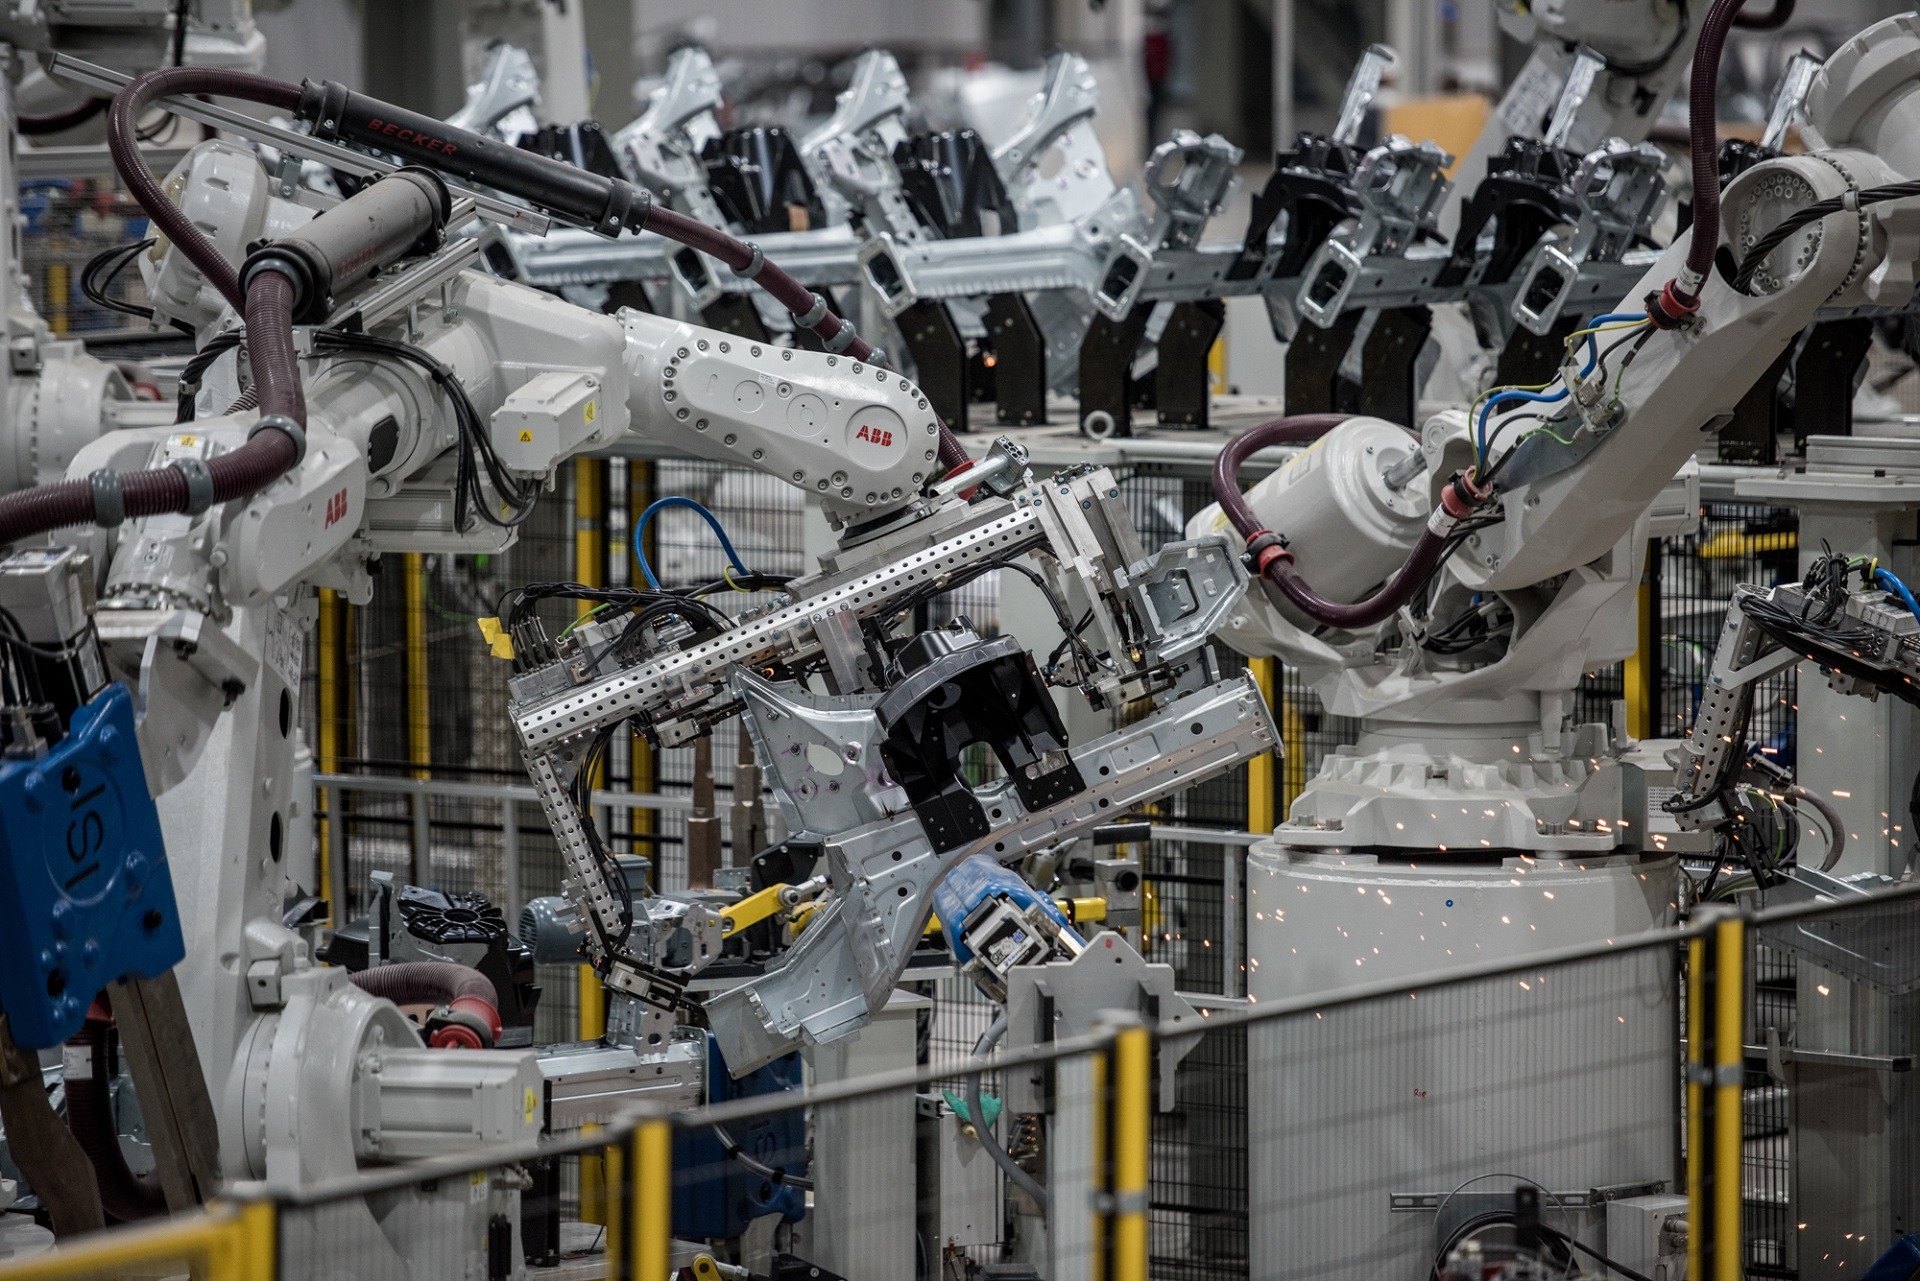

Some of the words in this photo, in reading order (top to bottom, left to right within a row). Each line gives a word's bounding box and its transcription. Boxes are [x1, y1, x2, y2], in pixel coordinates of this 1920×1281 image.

[368, 118, 457, 156] BECKER
[855, 424, 893, 447] ABB
[324, 487, 348, 530] ABB
[64, 782, 106, 891] ISI
